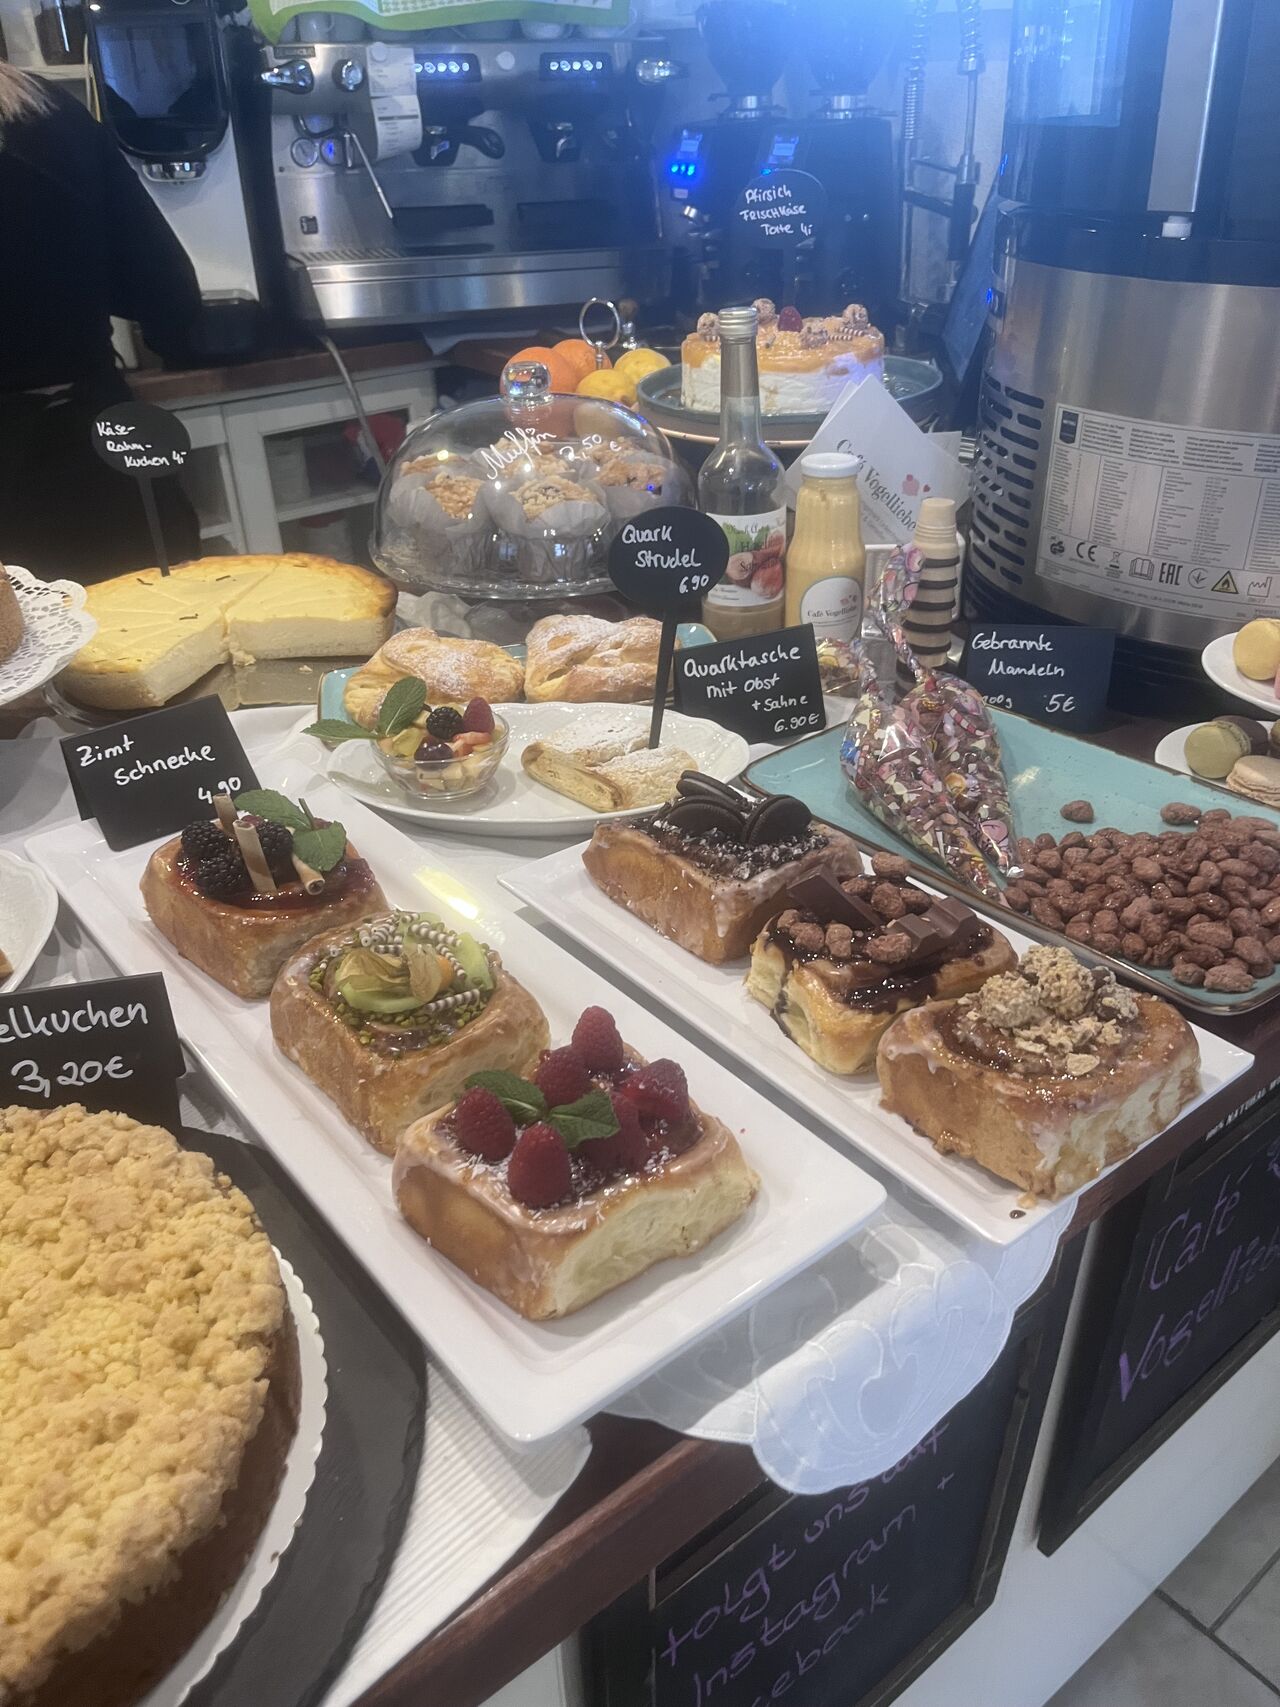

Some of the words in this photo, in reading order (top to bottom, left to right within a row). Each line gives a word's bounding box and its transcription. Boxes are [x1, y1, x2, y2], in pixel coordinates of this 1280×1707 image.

[124, 455, 170, 468] Kuchen
[480, 427, 557, 480] Muffin
[622, 524, 673, 544] Quark
[679, 574, 710, 594] 6.90
[971, 631, 1054, 651] Gebrannte
[683, 644, 801, 678] Quarktasche
[987, 658, 1065, 677] Mandeln
[706, 680, 737, 699] mit
[76, 734, 135, 767] Zimt
[114, 745, 216, 786] Schnecke
